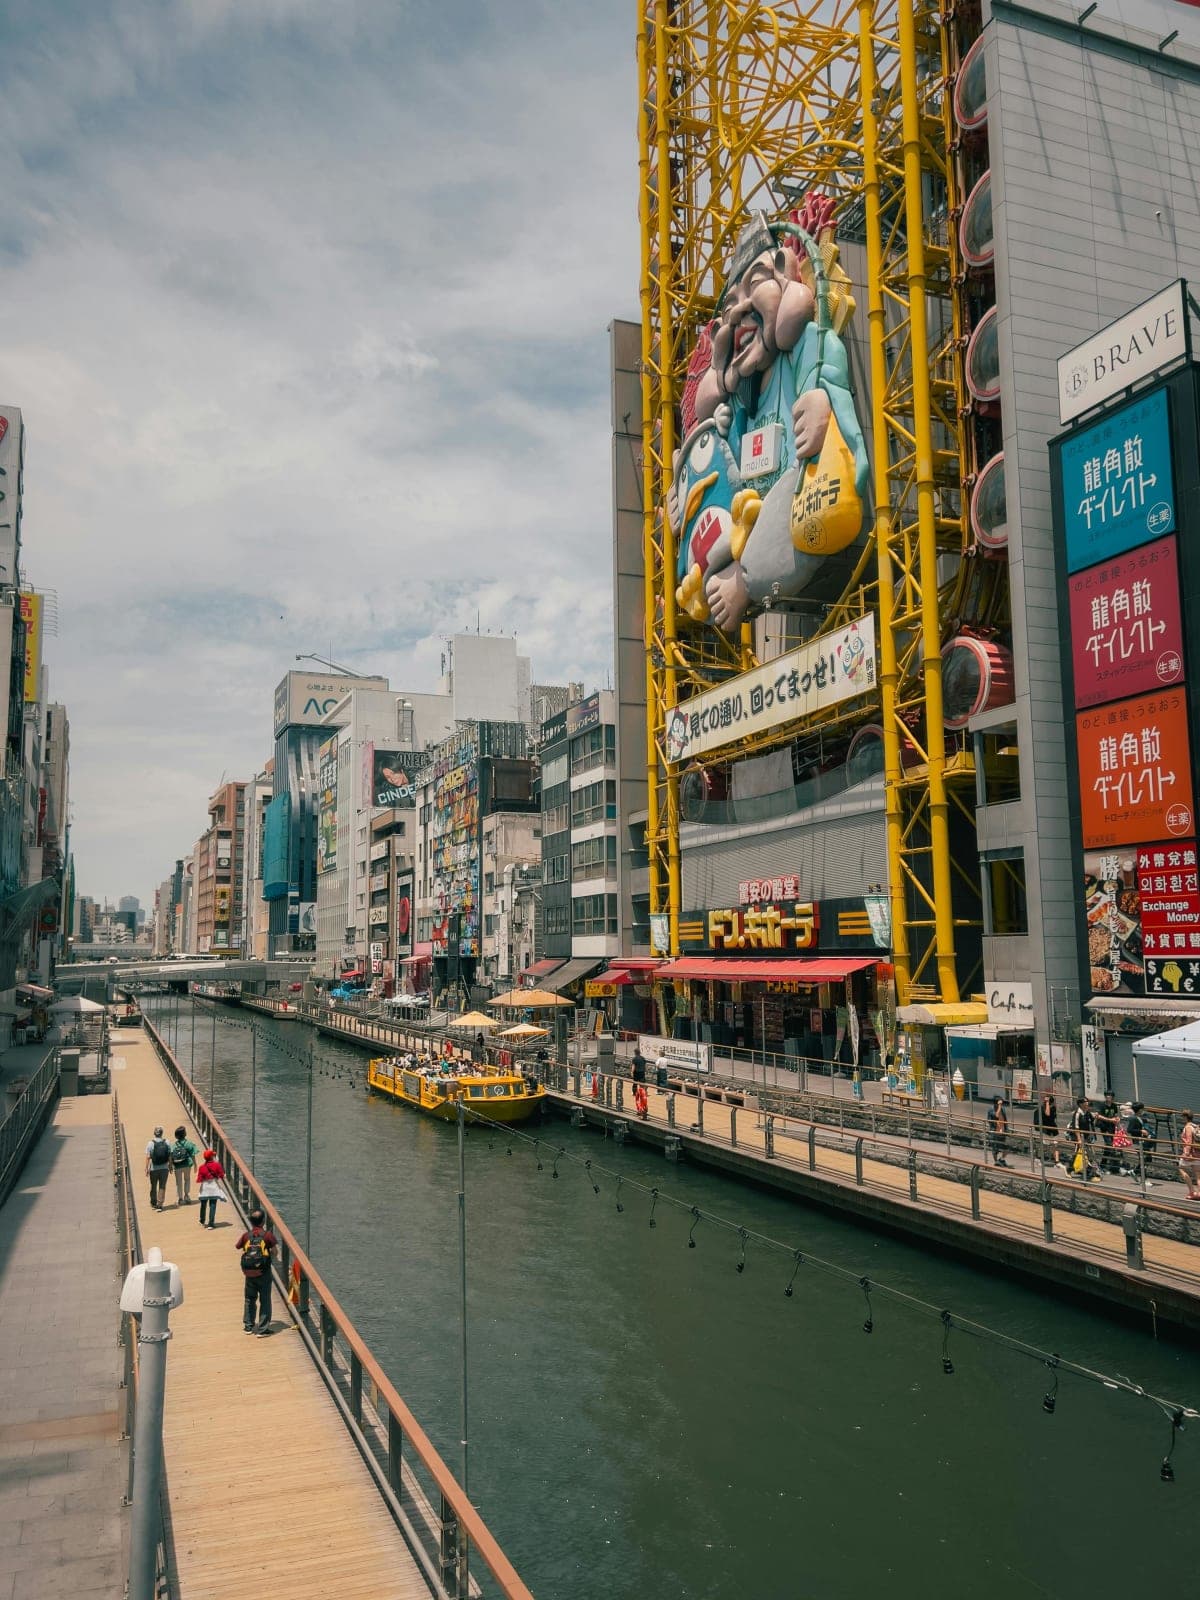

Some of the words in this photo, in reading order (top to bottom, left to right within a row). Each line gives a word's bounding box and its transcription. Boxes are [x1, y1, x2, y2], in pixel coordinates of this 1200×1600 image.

[1093, 309, 1177, 383] BRAVE
[1083, 434, 1144, 494] 龍角散
[1077, 471, 1157, 529] ダイレクト
[1148, 508, 1170, 527] 生薬
[1091, 578, 1152, 631] 龍角散
[1085, 617, 1166, 667] ダイレクト
[1157, 658, 1180, 675] 生薬
[1099, 725, 1162, 772] 龍角散
[1093, 766, 1176, 809] ダイレクト
[1167, 812, 1190, 826] 生薬
[1141, 873, 1198, 894] 외화환전
[1142, 901, 1189, 912] Exchange
[1167, 912, 1200, 923] Money
